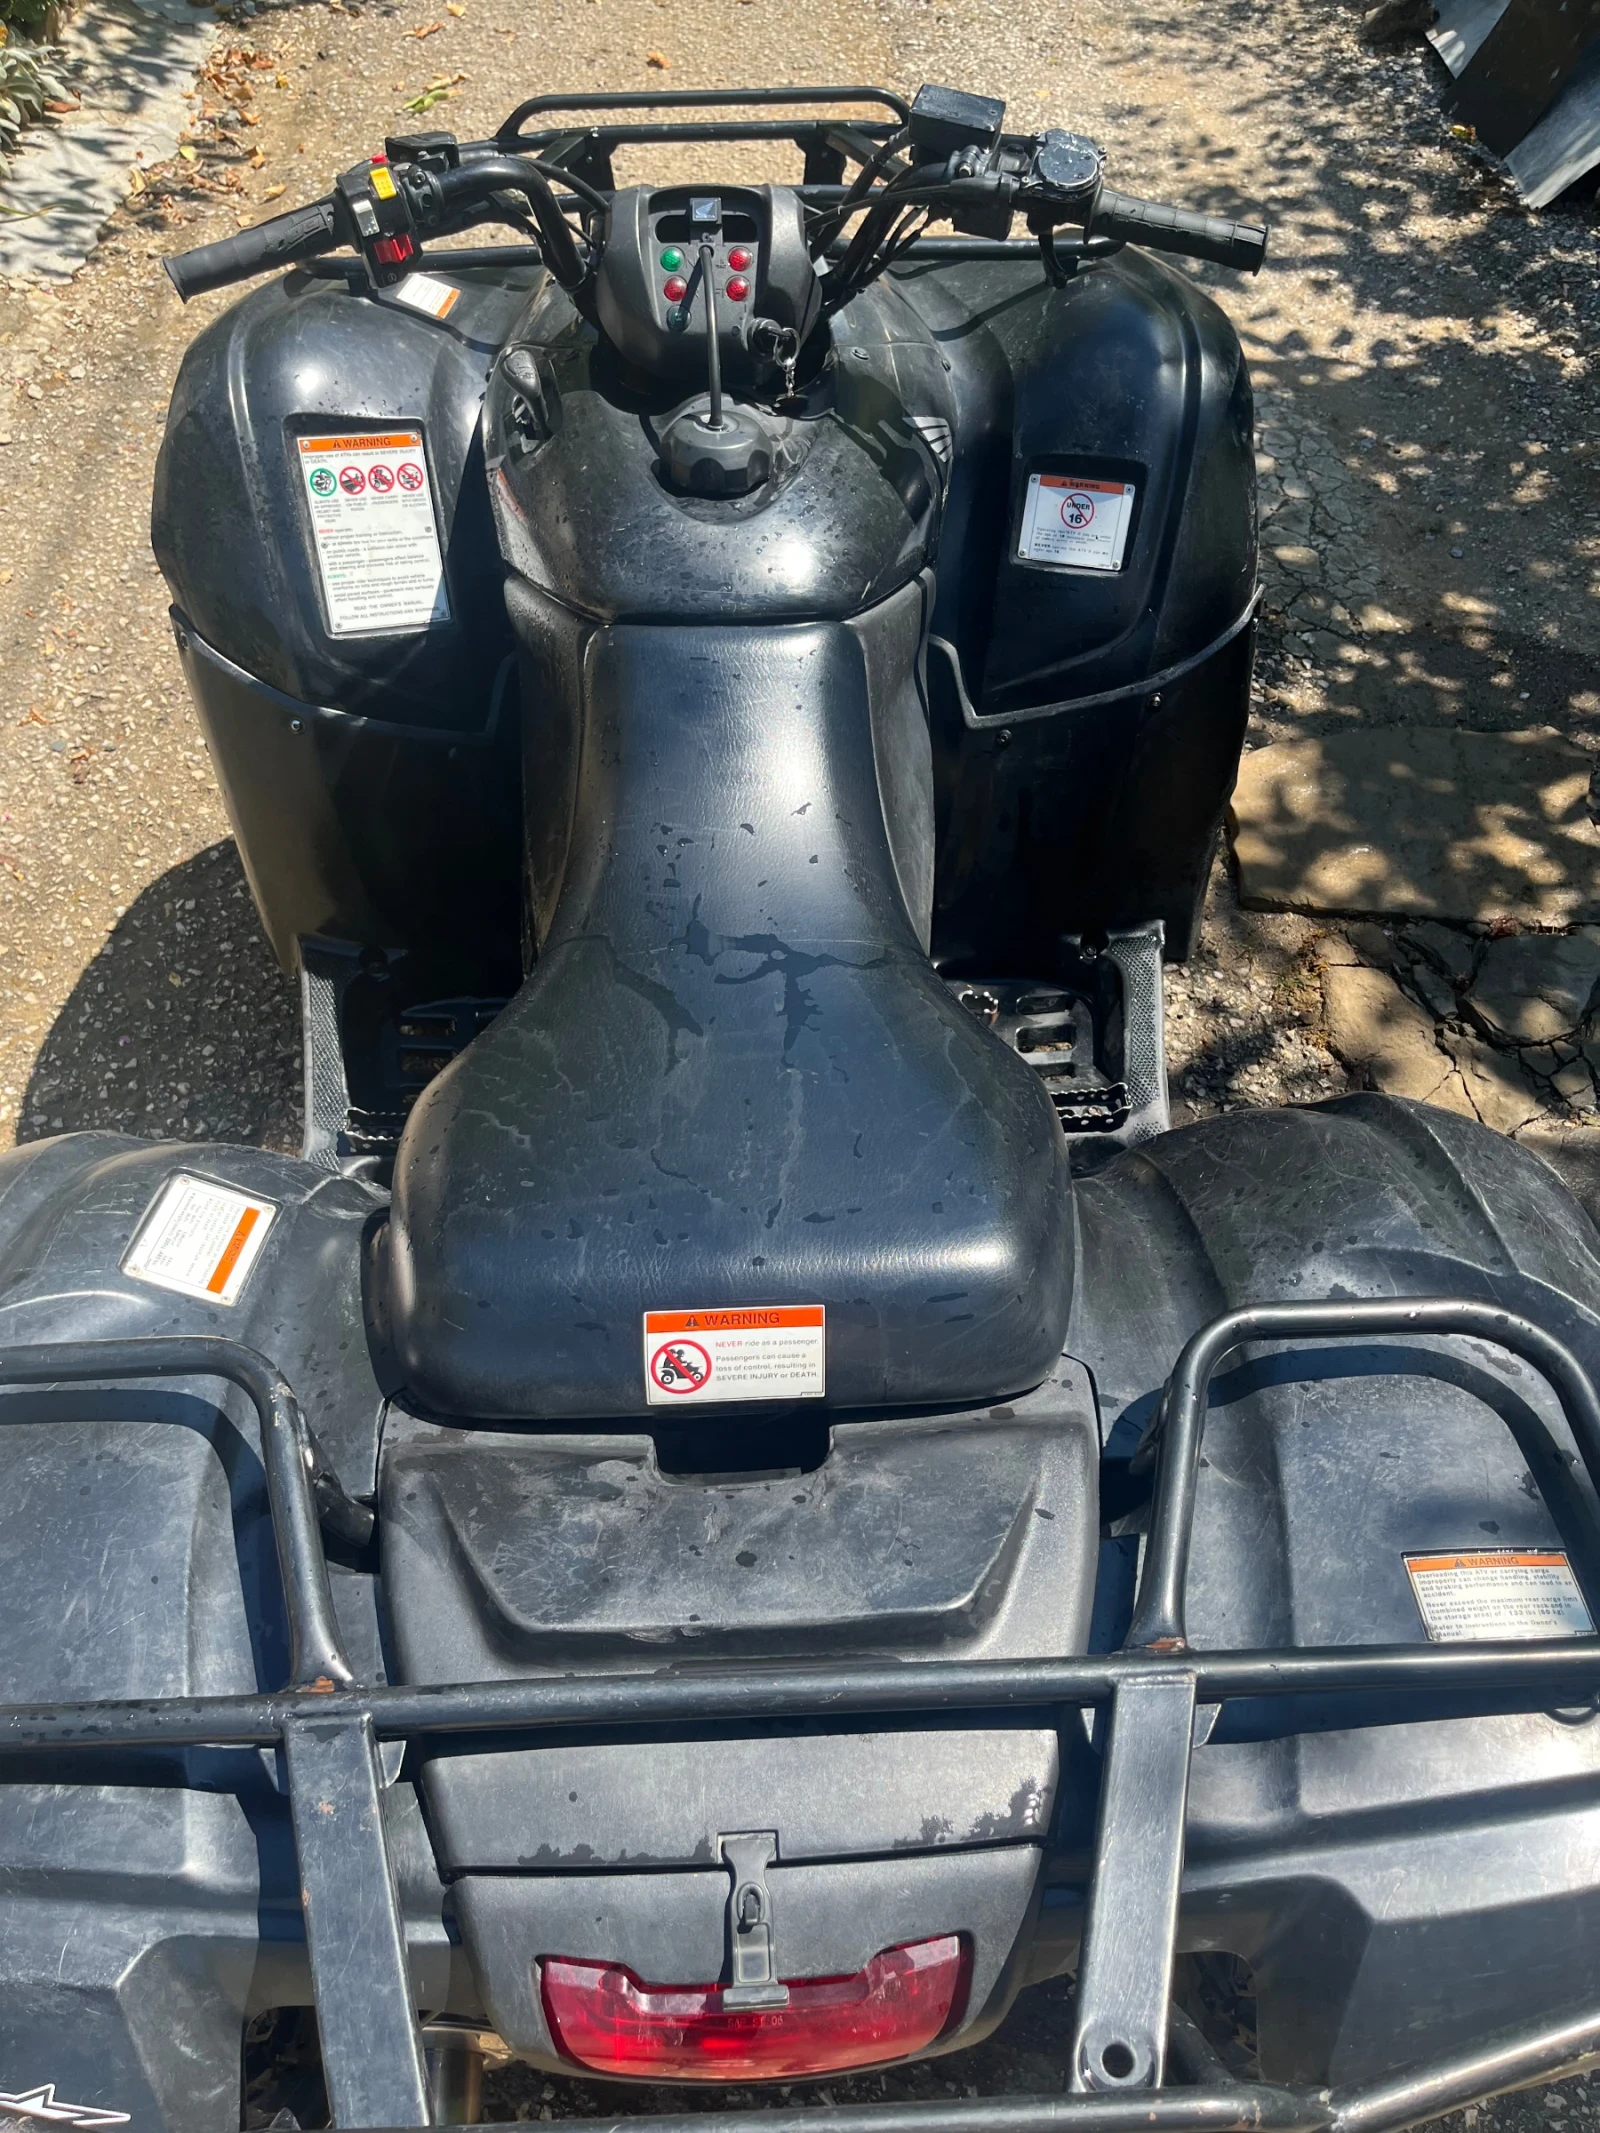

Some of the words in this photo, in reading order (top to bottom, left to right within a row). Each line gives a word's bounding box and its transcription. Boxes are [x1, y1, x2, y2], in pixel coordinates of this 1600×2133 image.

[342, 437, 391, 447] WARNING
[1069, 481, 1100, 489] WARNING
[1066, 501, 1090, 510] UNDER
[704, 1312, 779, 1326] WARNING
[716, 1354, 759, 1362] Passengers
[749, 1372, 776, 1380] INJURY
[1467, 1556, 1519, 1566] WARNING
[1427, 1606, 1466, 1614] (combined
[772, 2014, 784, 2026] 06
